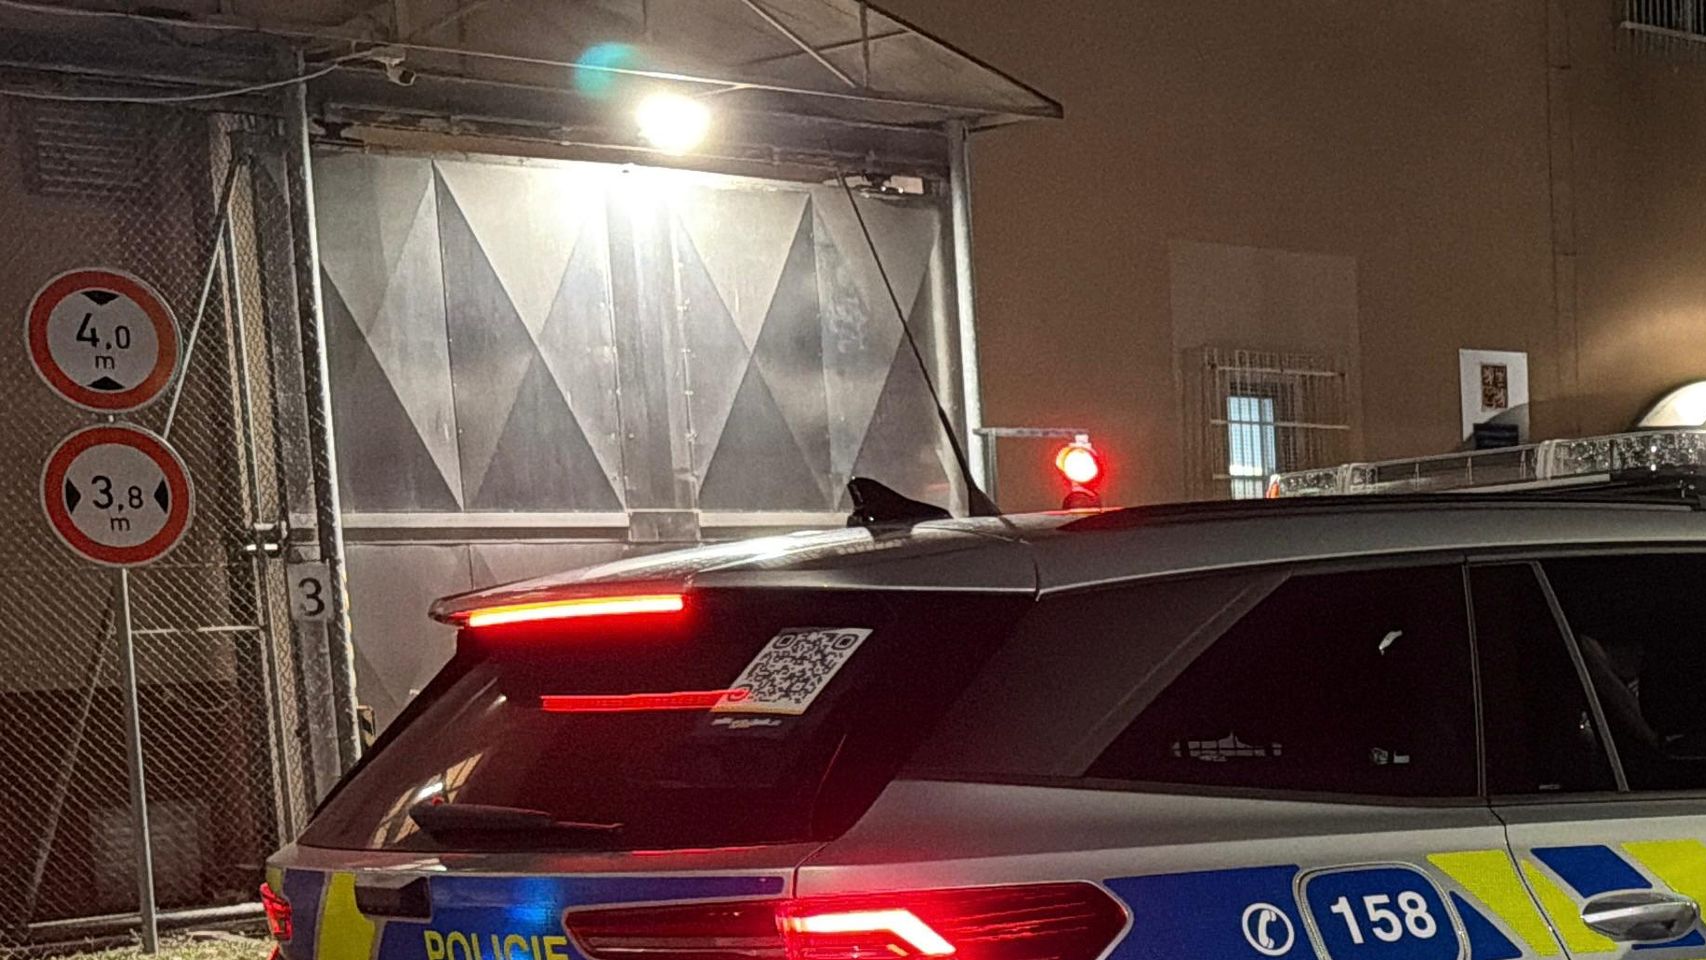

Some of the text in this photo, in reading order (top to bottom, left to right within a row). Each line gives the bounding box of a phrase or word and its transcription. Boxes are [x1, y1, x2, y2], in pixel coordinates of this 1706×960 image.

[95, 355, 115, 370] m
[91, 475, 144, 513] 3,8
[110, 517, 131, 531] m
[298, 577, 325, 617] 3
[1330, 890, 1437, 945] 158
